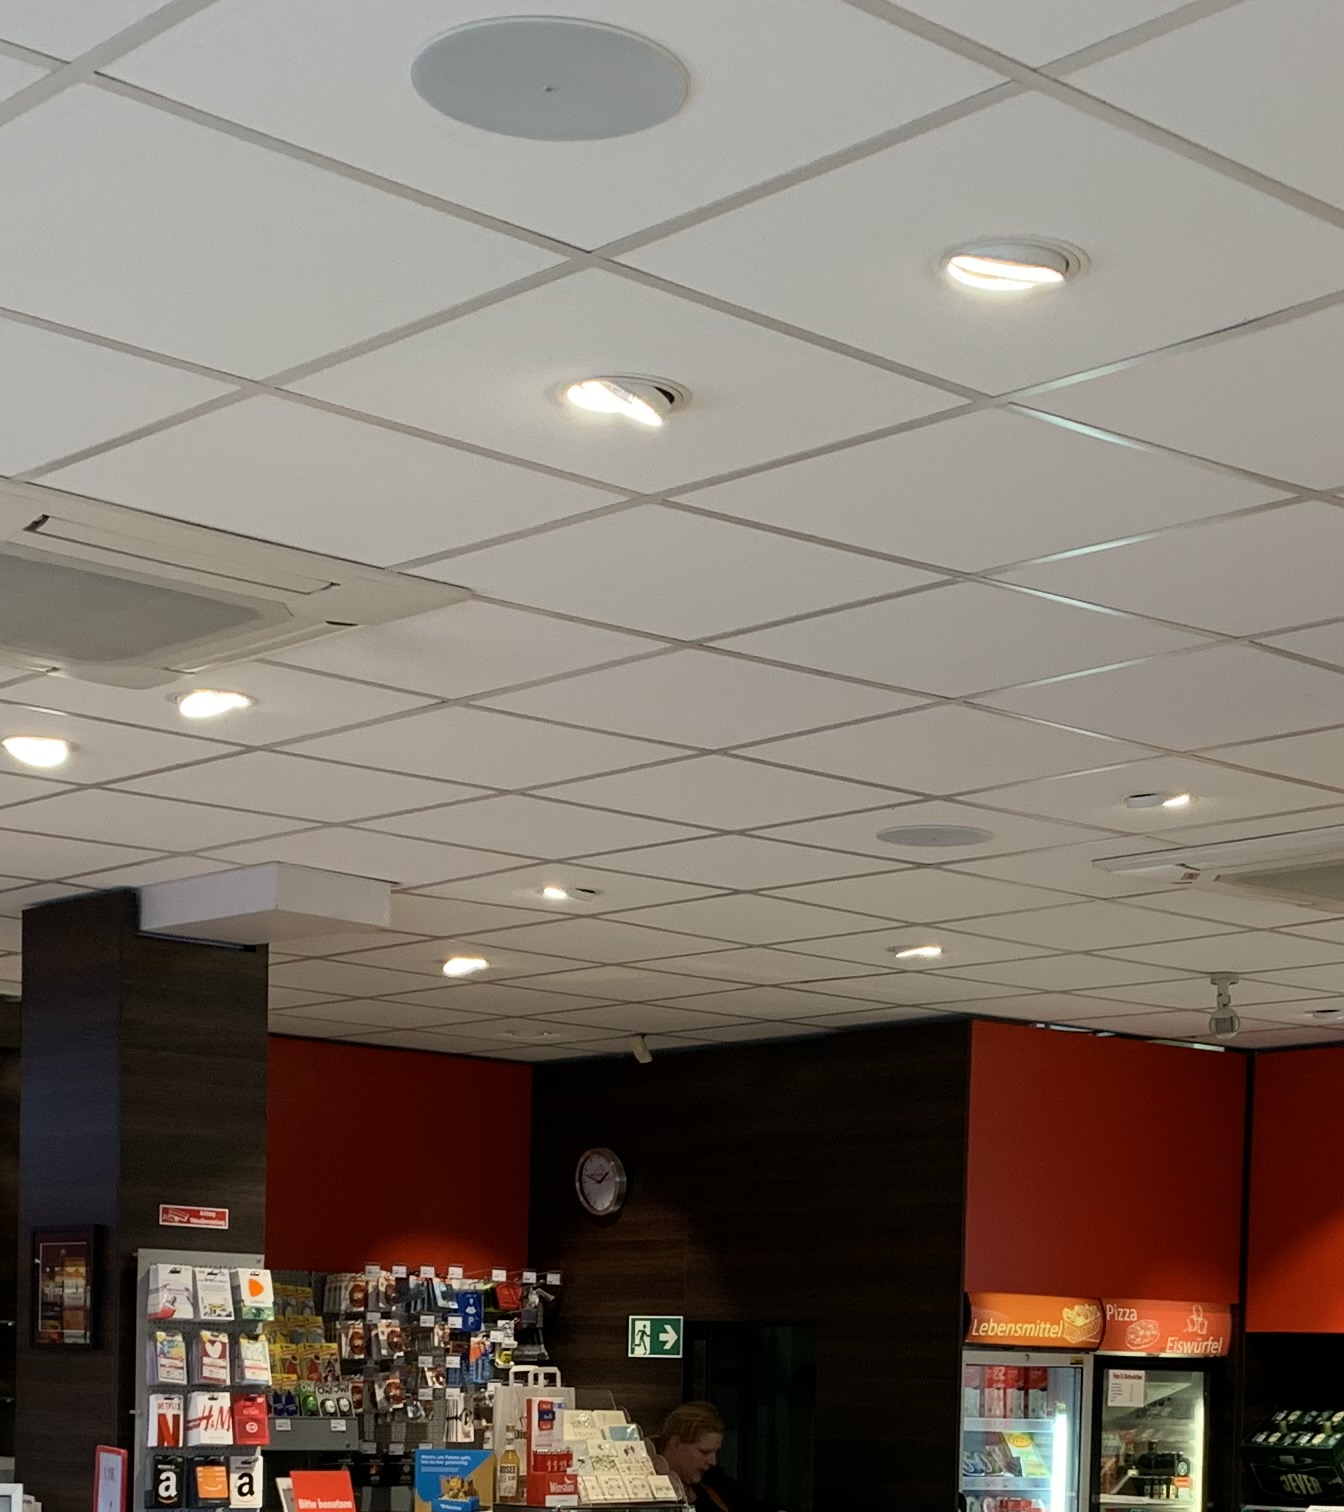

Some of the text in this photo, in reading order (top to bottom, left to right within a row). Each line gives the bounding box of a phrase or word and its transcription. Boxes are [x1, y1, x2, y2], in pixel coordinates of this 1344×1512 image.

[1106, 1304, 1137, 1321] Pizza
[972, 1319, 1063, 1338] Lebensmittel
[1166, 1336, 1223, 1354] Eiswürfel
